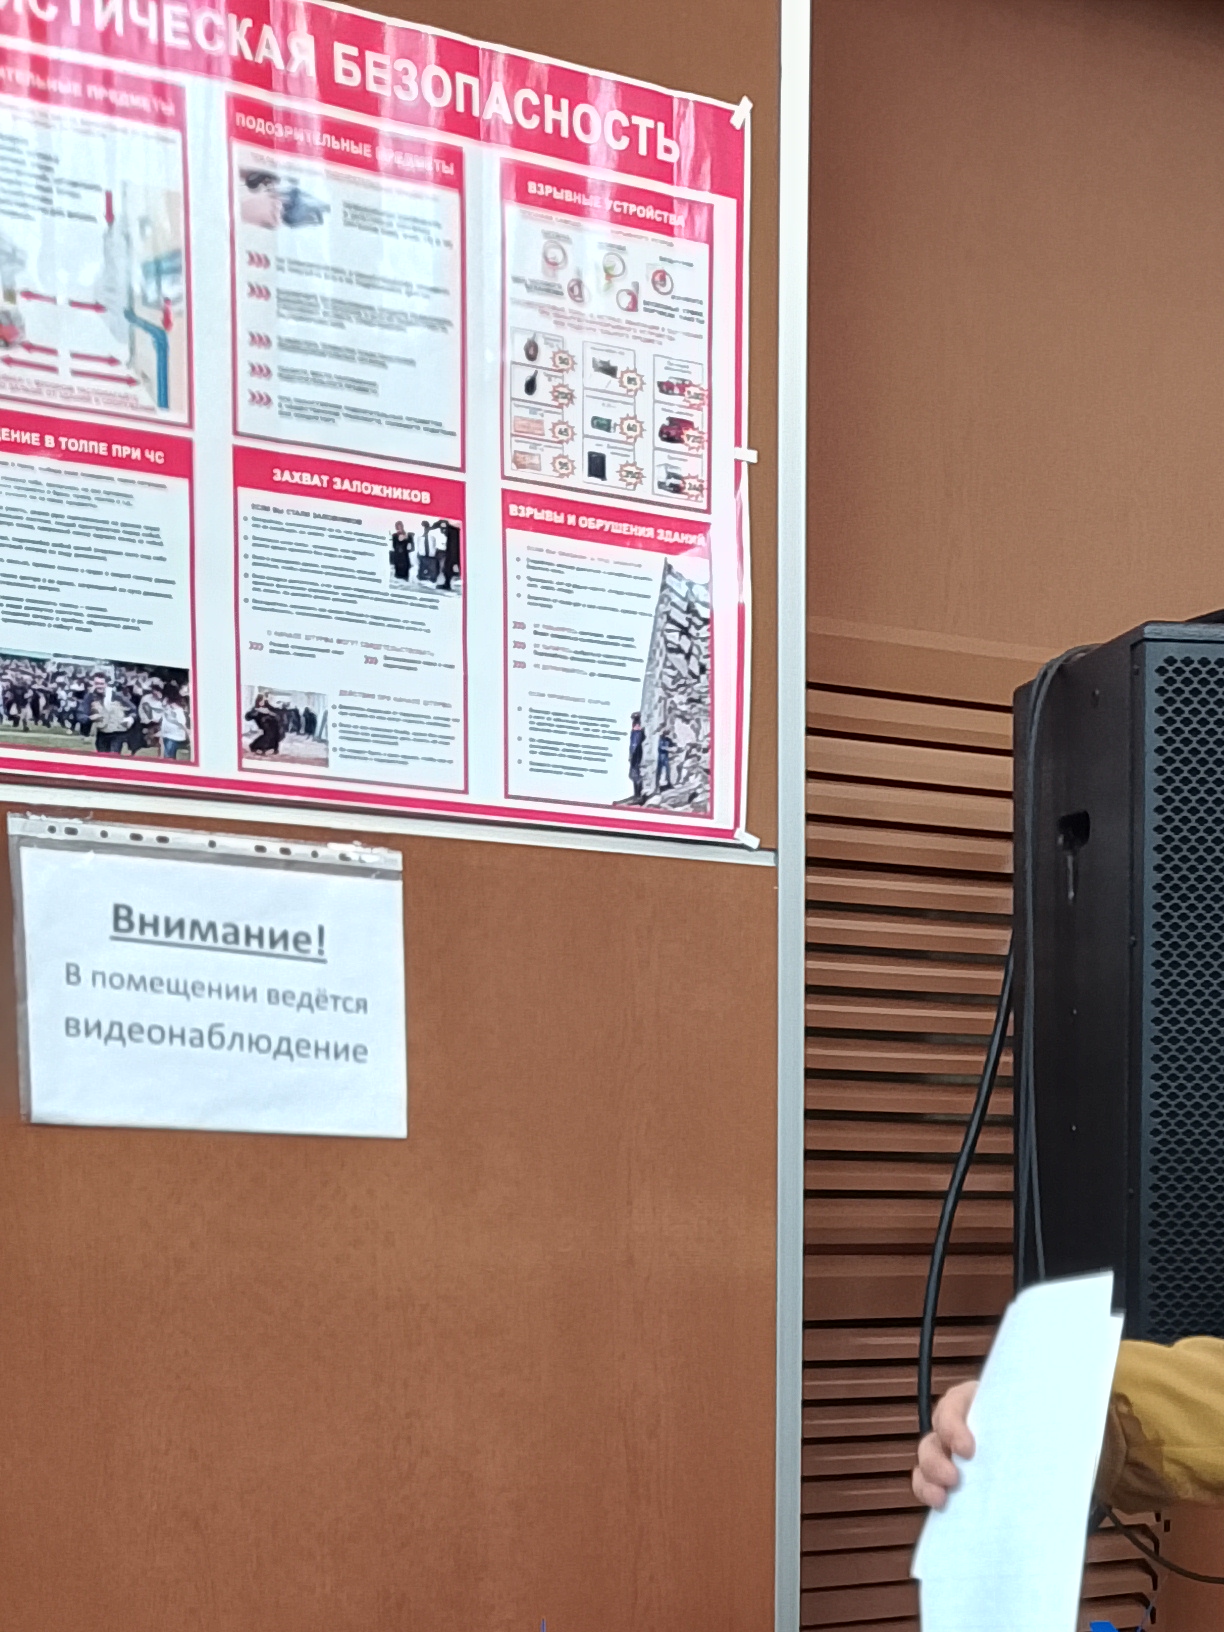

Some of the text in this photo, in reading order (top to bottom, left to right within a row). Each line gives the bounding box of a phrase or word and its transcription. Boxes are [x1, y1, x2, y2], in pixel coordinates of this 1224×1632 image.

[0, 0, 681, 163] СТИЧЕСКАЯ БЕЗОПАСНОСТЬ
[235, 112, 373, 158] ПОДОЗРИТЕЛЬНЫЕ
[375, 145, 455, 176] ПРЕДМЕТЫ
[527, 180, 602, 208] ВЗРЫВНЫЕ
[604, 200, 686, 227] УСТРОЙСТВА
[0, 427, 165, 464] ЕНИЕ В ТОЛПЕ ПРИ ЧС
[272, 468, 431, 505] ЗАХВАТ ЗАЛОЖНИКОВ
[508, 503, 707, 547] ВЗРЫВЫ И ОБРУШЕНИЯ ЗДАНИЙ
[112, 902, 326, 958] Внимание!
[64, 961, 370, 1015] В помещении ведётся
[63, 1015, 370, 1064] видеонаблюдение
